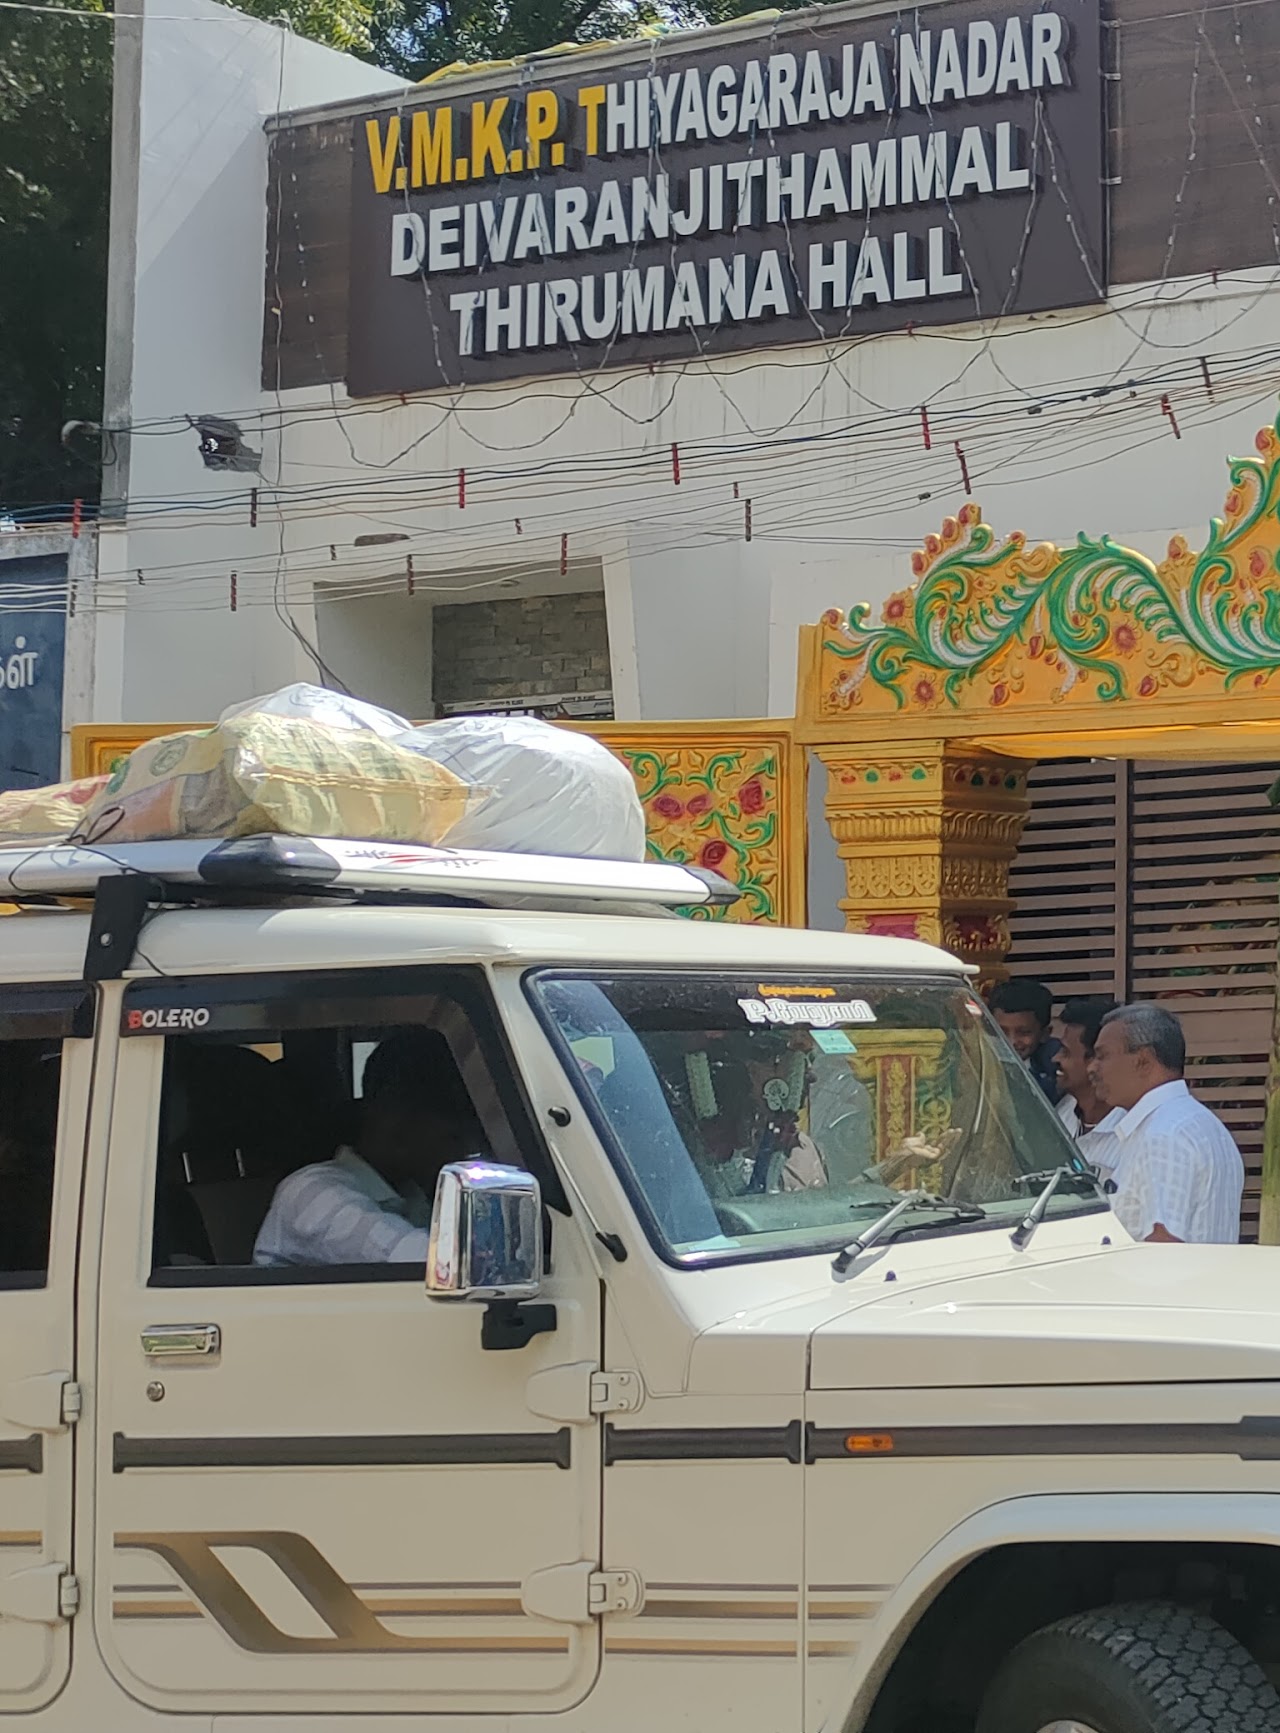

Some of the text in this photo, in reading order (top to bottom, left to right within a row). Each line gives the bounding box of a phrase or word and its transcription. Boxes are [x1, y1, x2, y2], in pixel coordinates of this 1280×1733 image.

[366, 12, 1064, 193] V.M.K.P. THIYAGARAJA NADAR
[390, 121, 1030, 276] DEIVARANJITHAMMAL
[450, 226, 963, 357] THIRUMANA HALL
[128, 1007, 210, 1030] BOLERO
